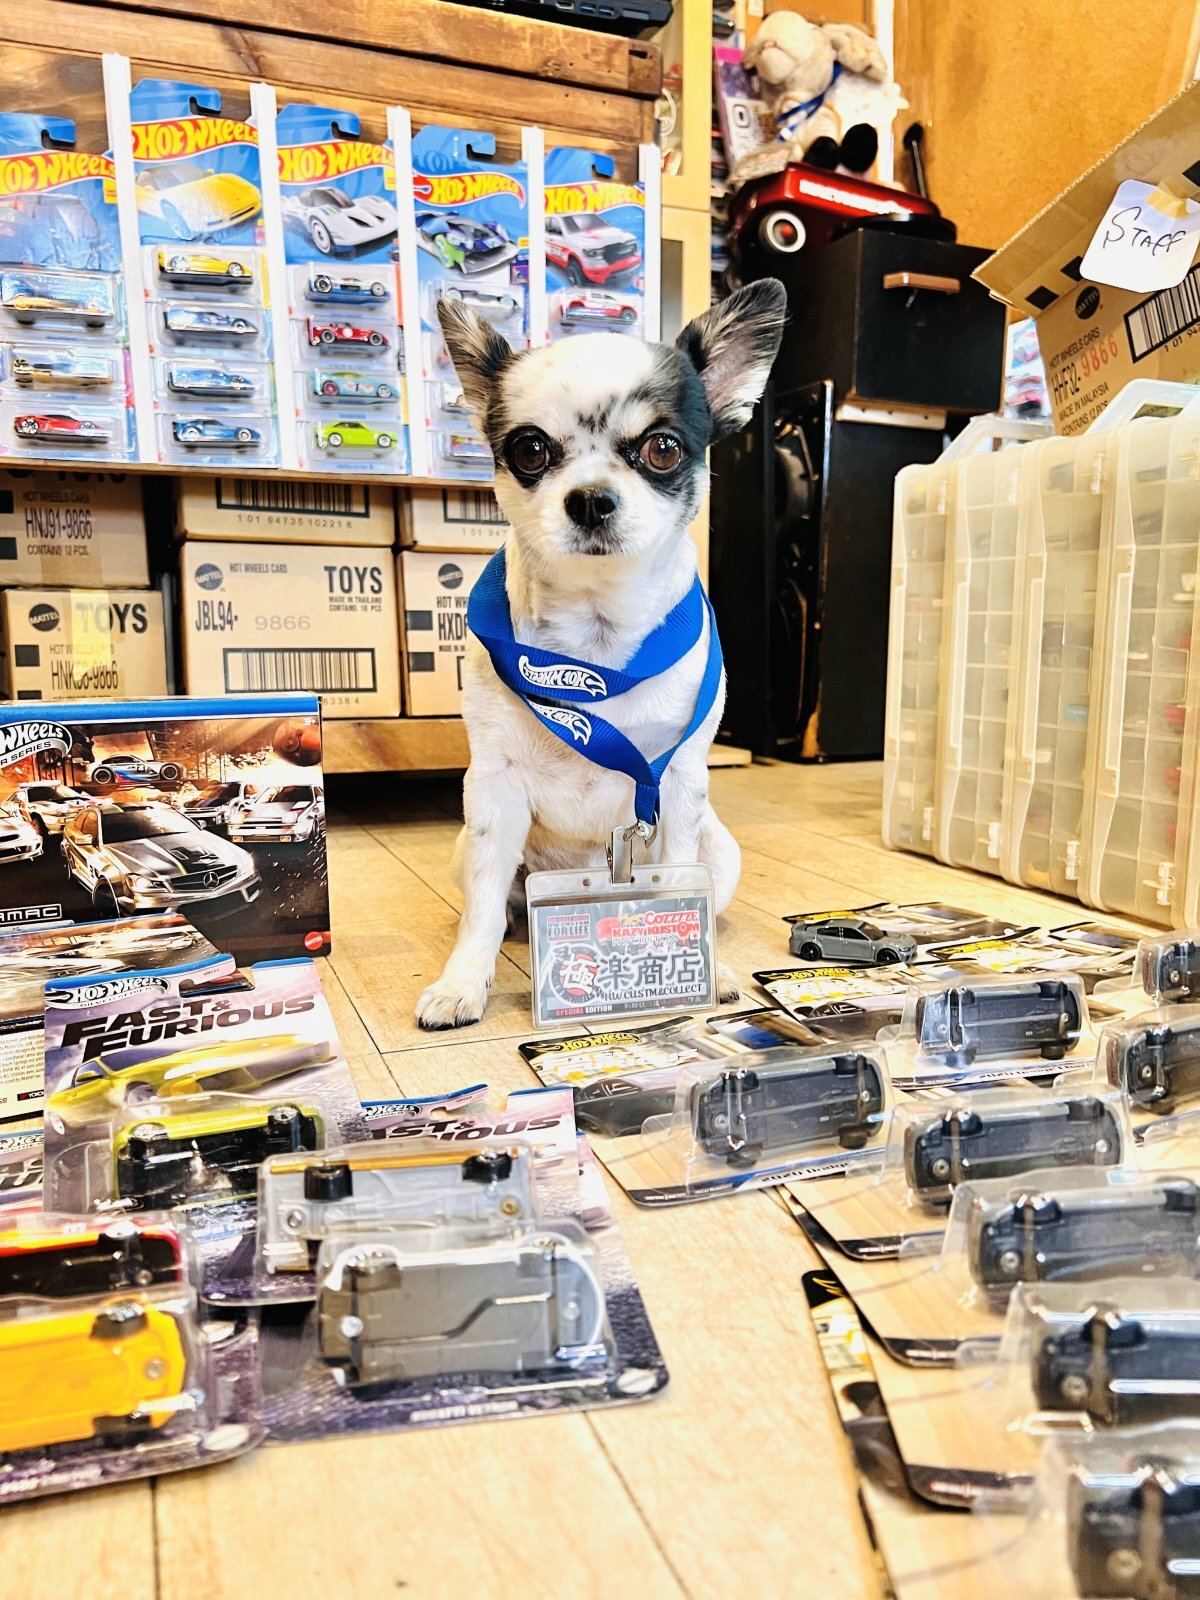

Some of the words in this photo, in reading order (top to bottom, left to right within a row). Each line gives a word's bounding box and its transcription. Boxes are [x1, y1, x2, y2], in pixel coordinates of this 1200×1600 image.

[1081, 334, 1118, 378] 9866
[1058, 405, 1075, 422] MADE
[1080, 382, 1110, 407] MALAYSIA
[24, 508, 93, 539] HNJ91-9866
[323, 565, 383, 595] TOYS
[436, 595, 453, 609] HOT
[254, 615, 311, 631] 9866
[11, 741, 52, 762] SERIES
[548, 926, 569, 937] FOR
[569, 924, 590, 936] LIFE
[584, 1004, 614, 1015] EDITION
[61, 999, 212, 1049] FAST
[210, 999, 233, 1013] &
[82, 995, 315, 1063] FURIOUS
[453, 1119, 476, 1130] &
